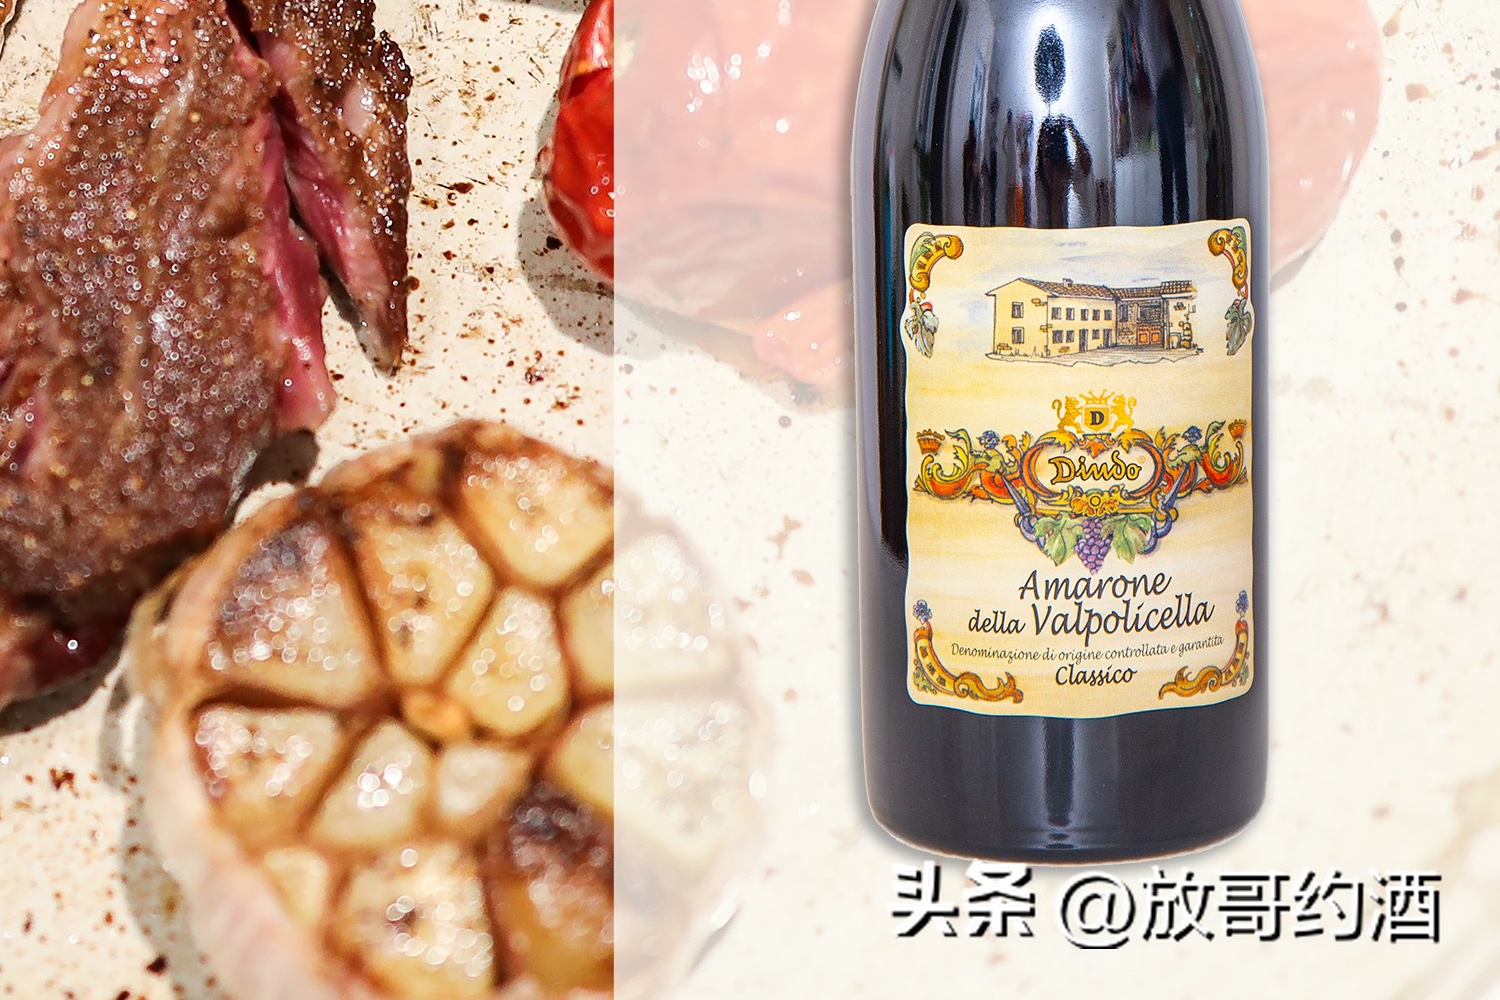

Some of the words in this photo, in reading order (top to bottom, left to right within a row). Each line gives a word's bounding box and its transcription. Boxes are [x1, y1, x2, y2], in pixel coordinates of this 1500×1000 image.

[1090, 410, 1105, 426] D
[1048, 450, 1142, 485] Dindo
[1018, 569, 1172, 601] Amarone
[968, 608, 1026, 635] della
[1031, 592, 1215, 647] Valpolicella
[951, 642, 1041, 664] Denominazione
[1042, 647, 1057, 661] di
[1058, 648, 1103, 665] origine
[1105, 642, 1169, 660] controllata
[1170, 645, 1178, 654] e
[1178, 634, 1224, 657] garantita
[1055, 663, 1137, 687] Classico
